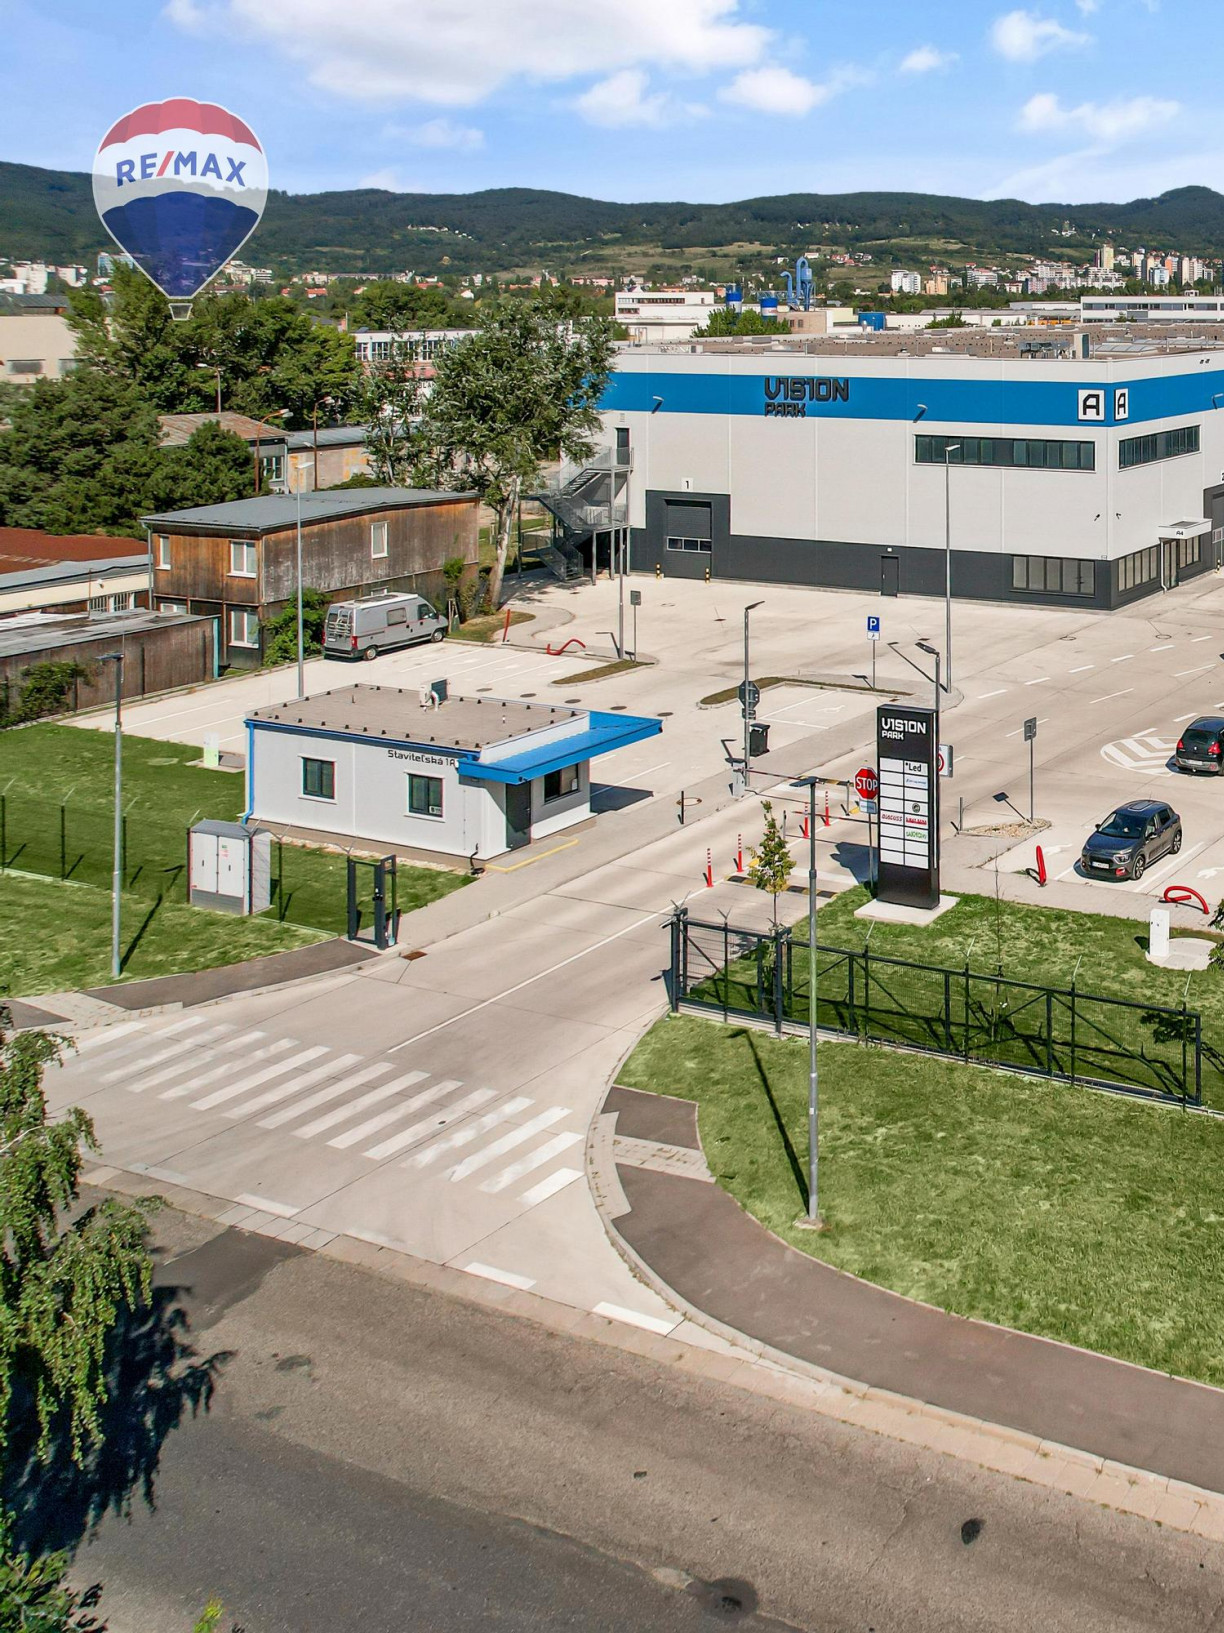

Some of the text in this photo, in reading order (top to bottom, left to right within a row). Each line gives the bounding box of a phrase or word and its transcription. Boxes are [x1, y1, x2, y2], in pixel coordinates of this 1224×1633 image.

[764, 401, 806, 418] PARK
[1082, 393, 1100, 416] A
[1117, 392, 1126, 415] A
[869, 618, 877, 629] P
[881, 730, 904, 740] PARK
[387, 749, 443, 766] Staviteľská
[908, 764, 922, 772] Led
[856, 776, 878, 791] STOP
